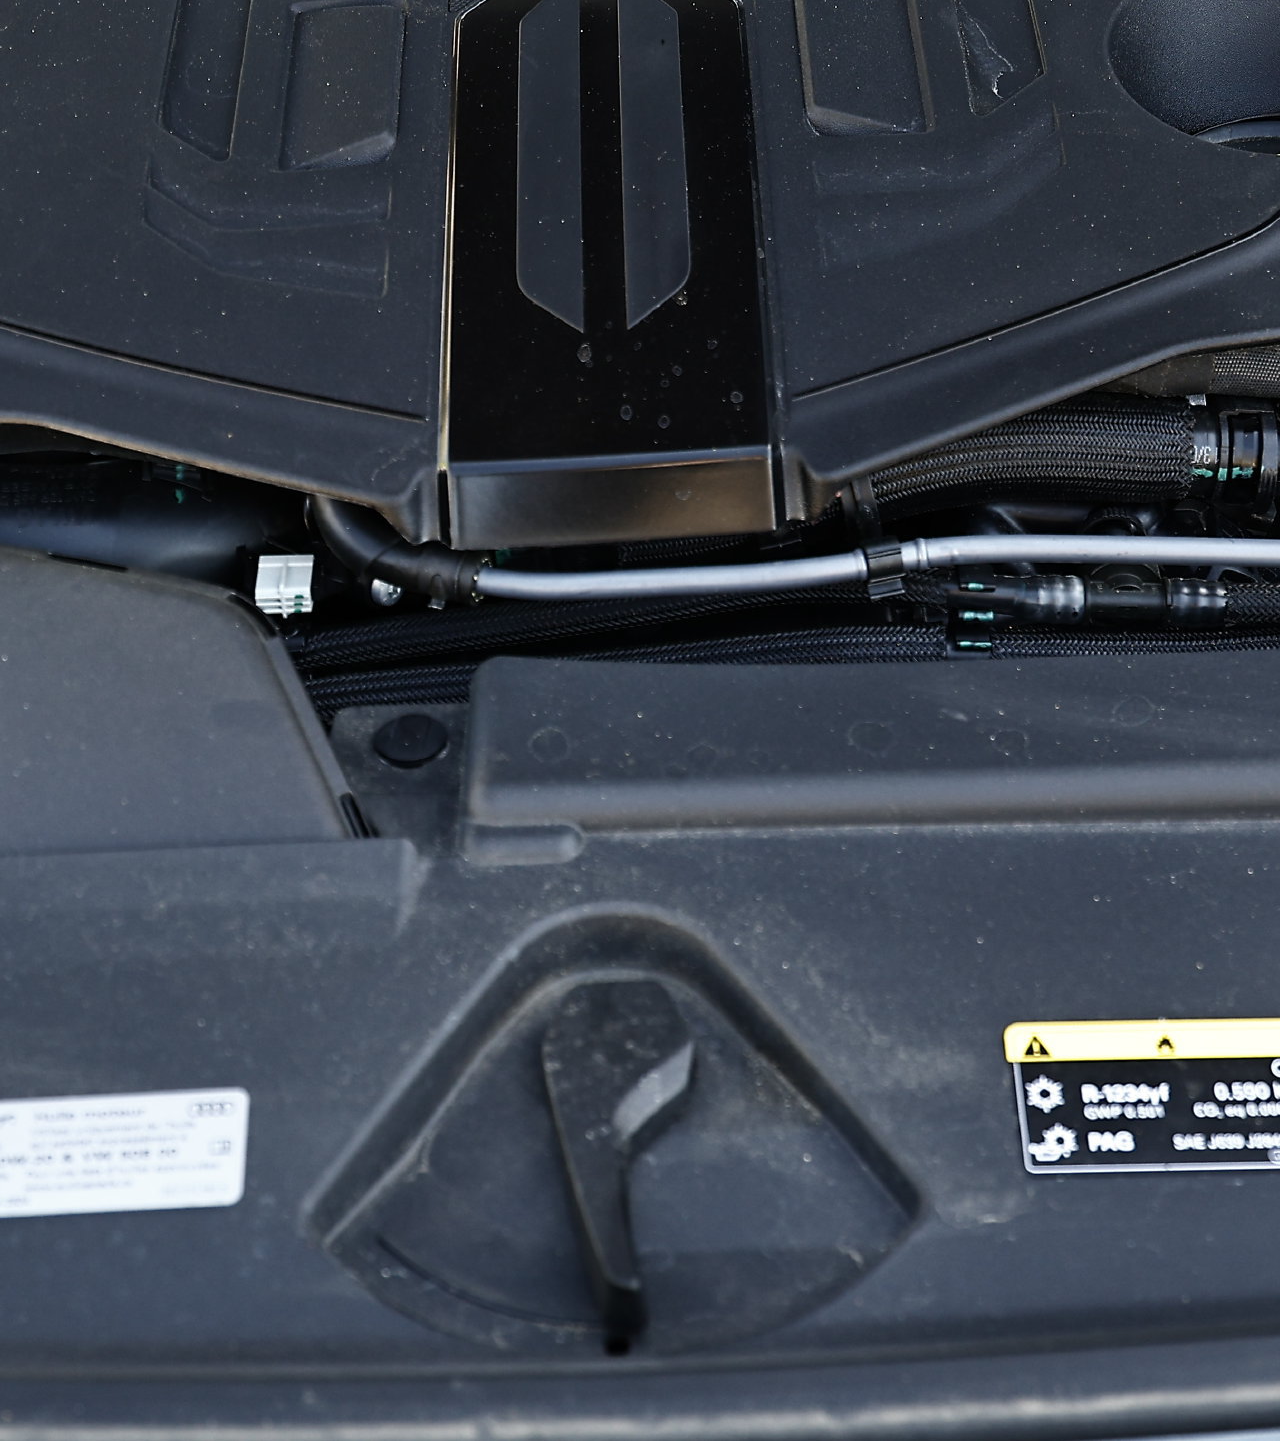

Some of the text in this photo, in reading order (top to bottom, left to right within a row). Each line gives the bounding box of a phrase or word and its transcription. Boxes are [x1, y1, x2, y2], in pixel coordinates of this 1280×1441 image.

[1081, 1082, 1170, 1105] R-1234yf
[1083, 1104, 1123, 1120] GWP
[1087, 1130, 1135, 1152] PAG
[1172, 1133, 1206, 1150] SAE
